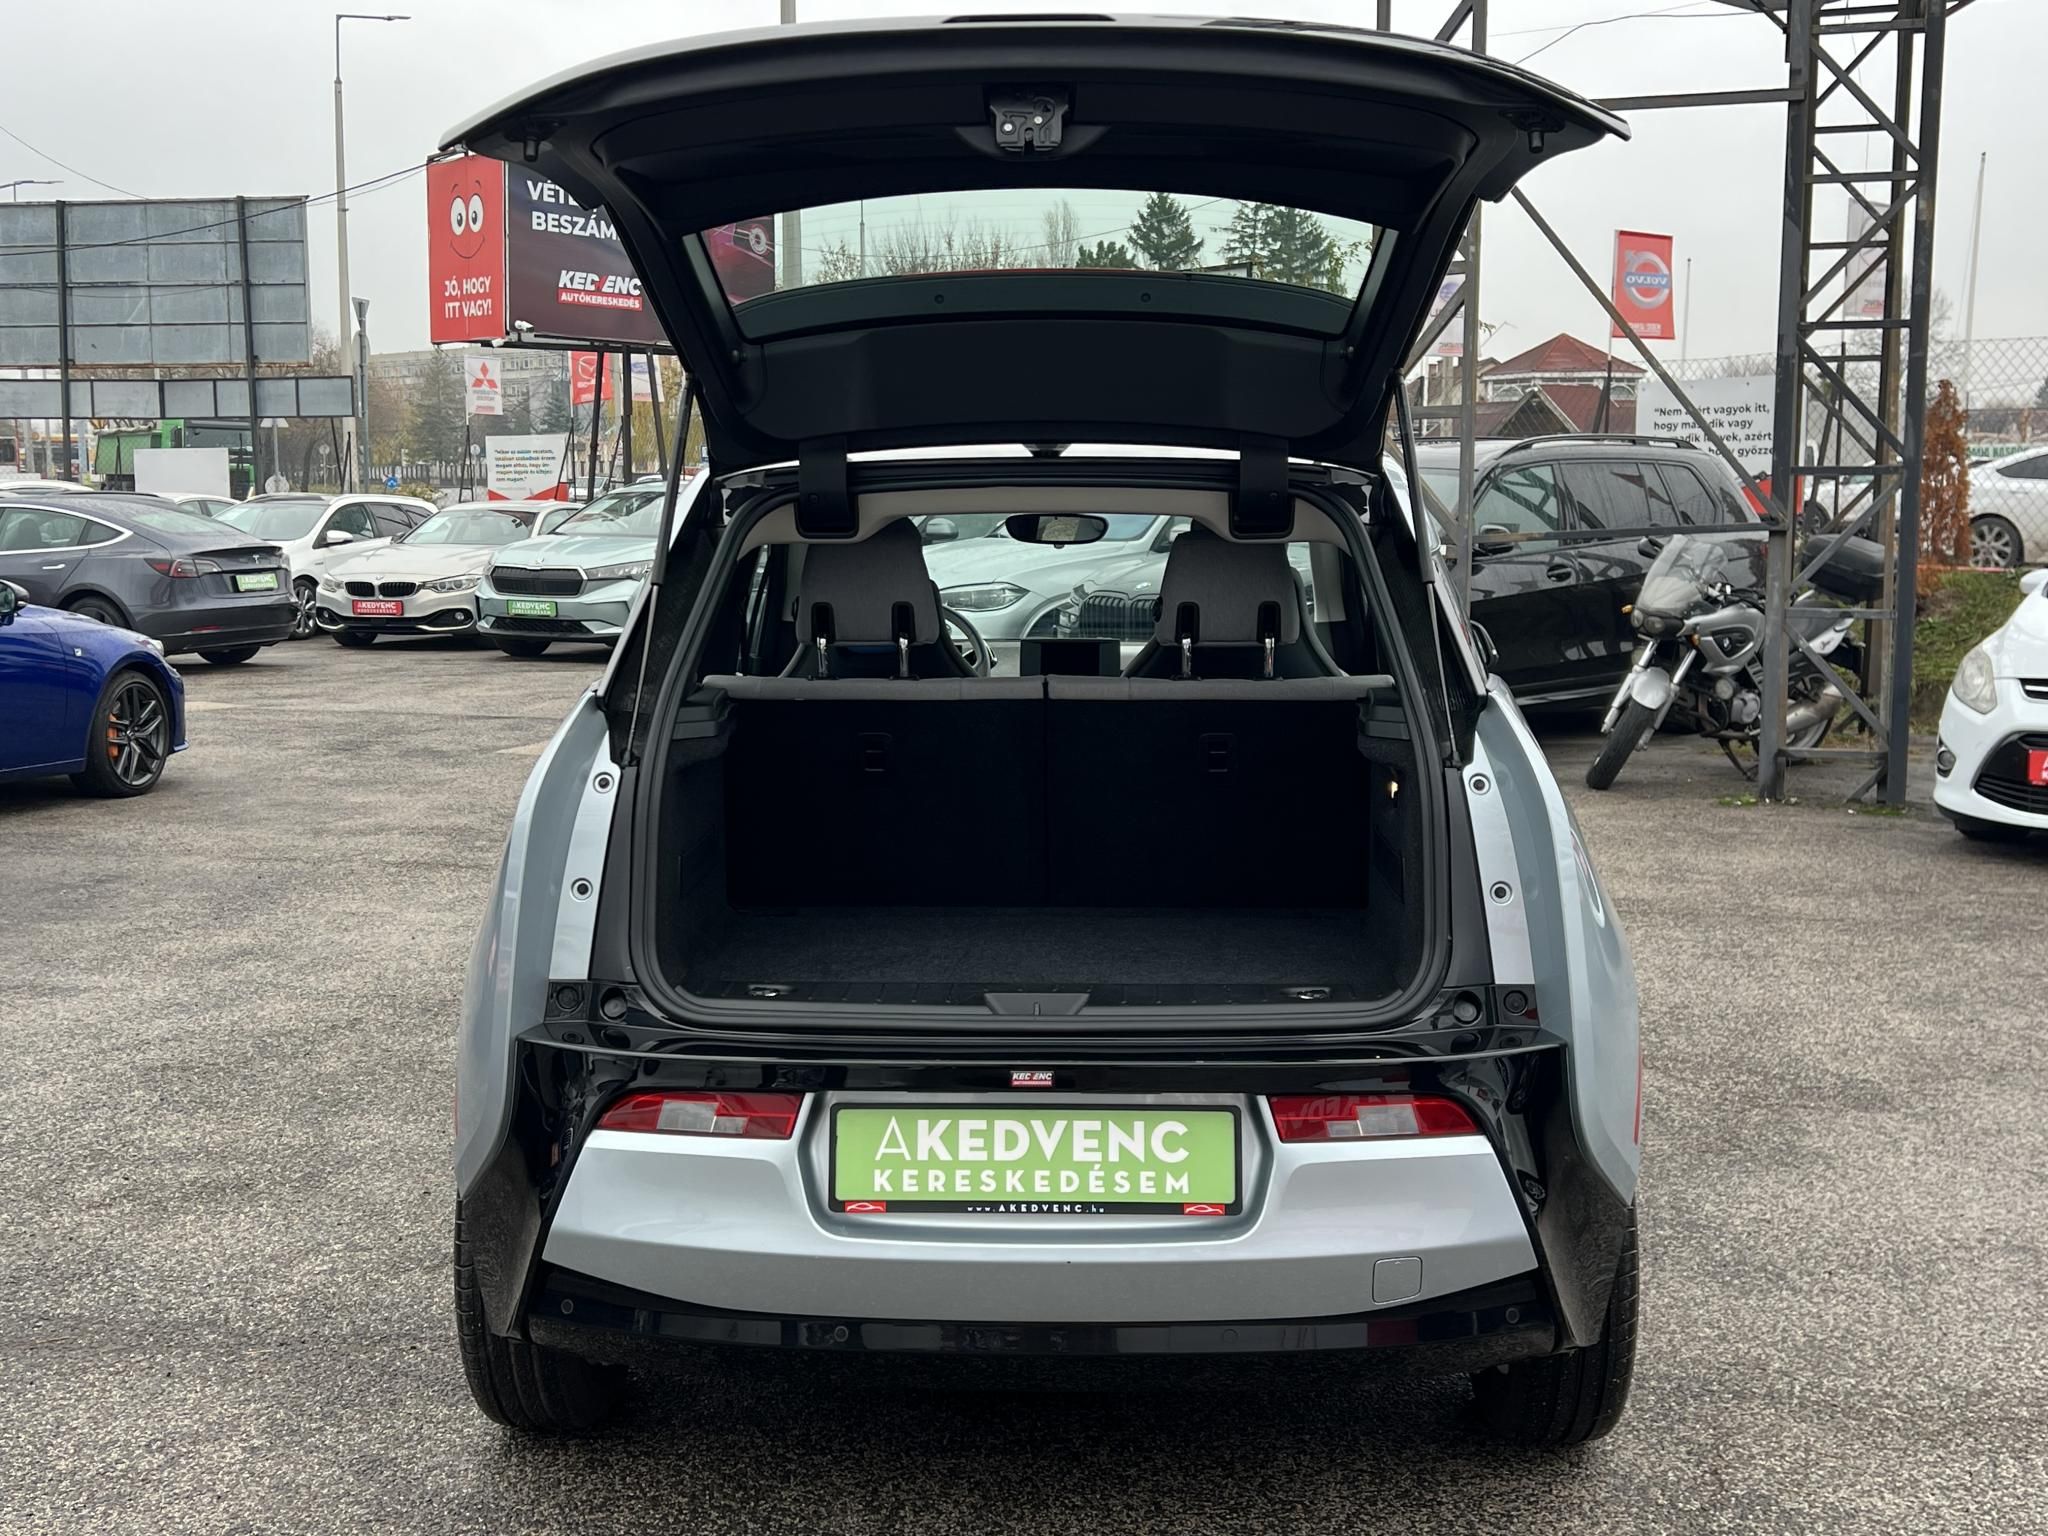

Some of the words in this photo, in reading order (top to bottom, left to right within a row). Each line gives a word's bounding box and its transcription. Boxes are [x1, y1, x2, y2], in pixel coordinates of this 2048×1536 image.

[526, 179, 579, 207] VÉT
[532, 210, 620, 241] BESZÁM
[444, 275, 461, 299] JÓ,
[462, 276, 492, 295] HOGY
[445, 301, 461, 319] ITT
[462, 298, 492, 318] VAGY!
[561, 291, 640, 309] AUTÓKERESKEDÉS
[1713, 403, 1752, 416] vagyok
[1754, 402, 1770, 414] itt,
[1654, 421, 1679, 432] hogy
[1728, 420, 1754, 430] vagy
[874, 1115, 1190, 1163] AKEDVENC
[873, 1163, 1190, 1194] KERESKEDÉSEM
[967, 1203, 1105, 1214] www.AKEDVENC.hu
